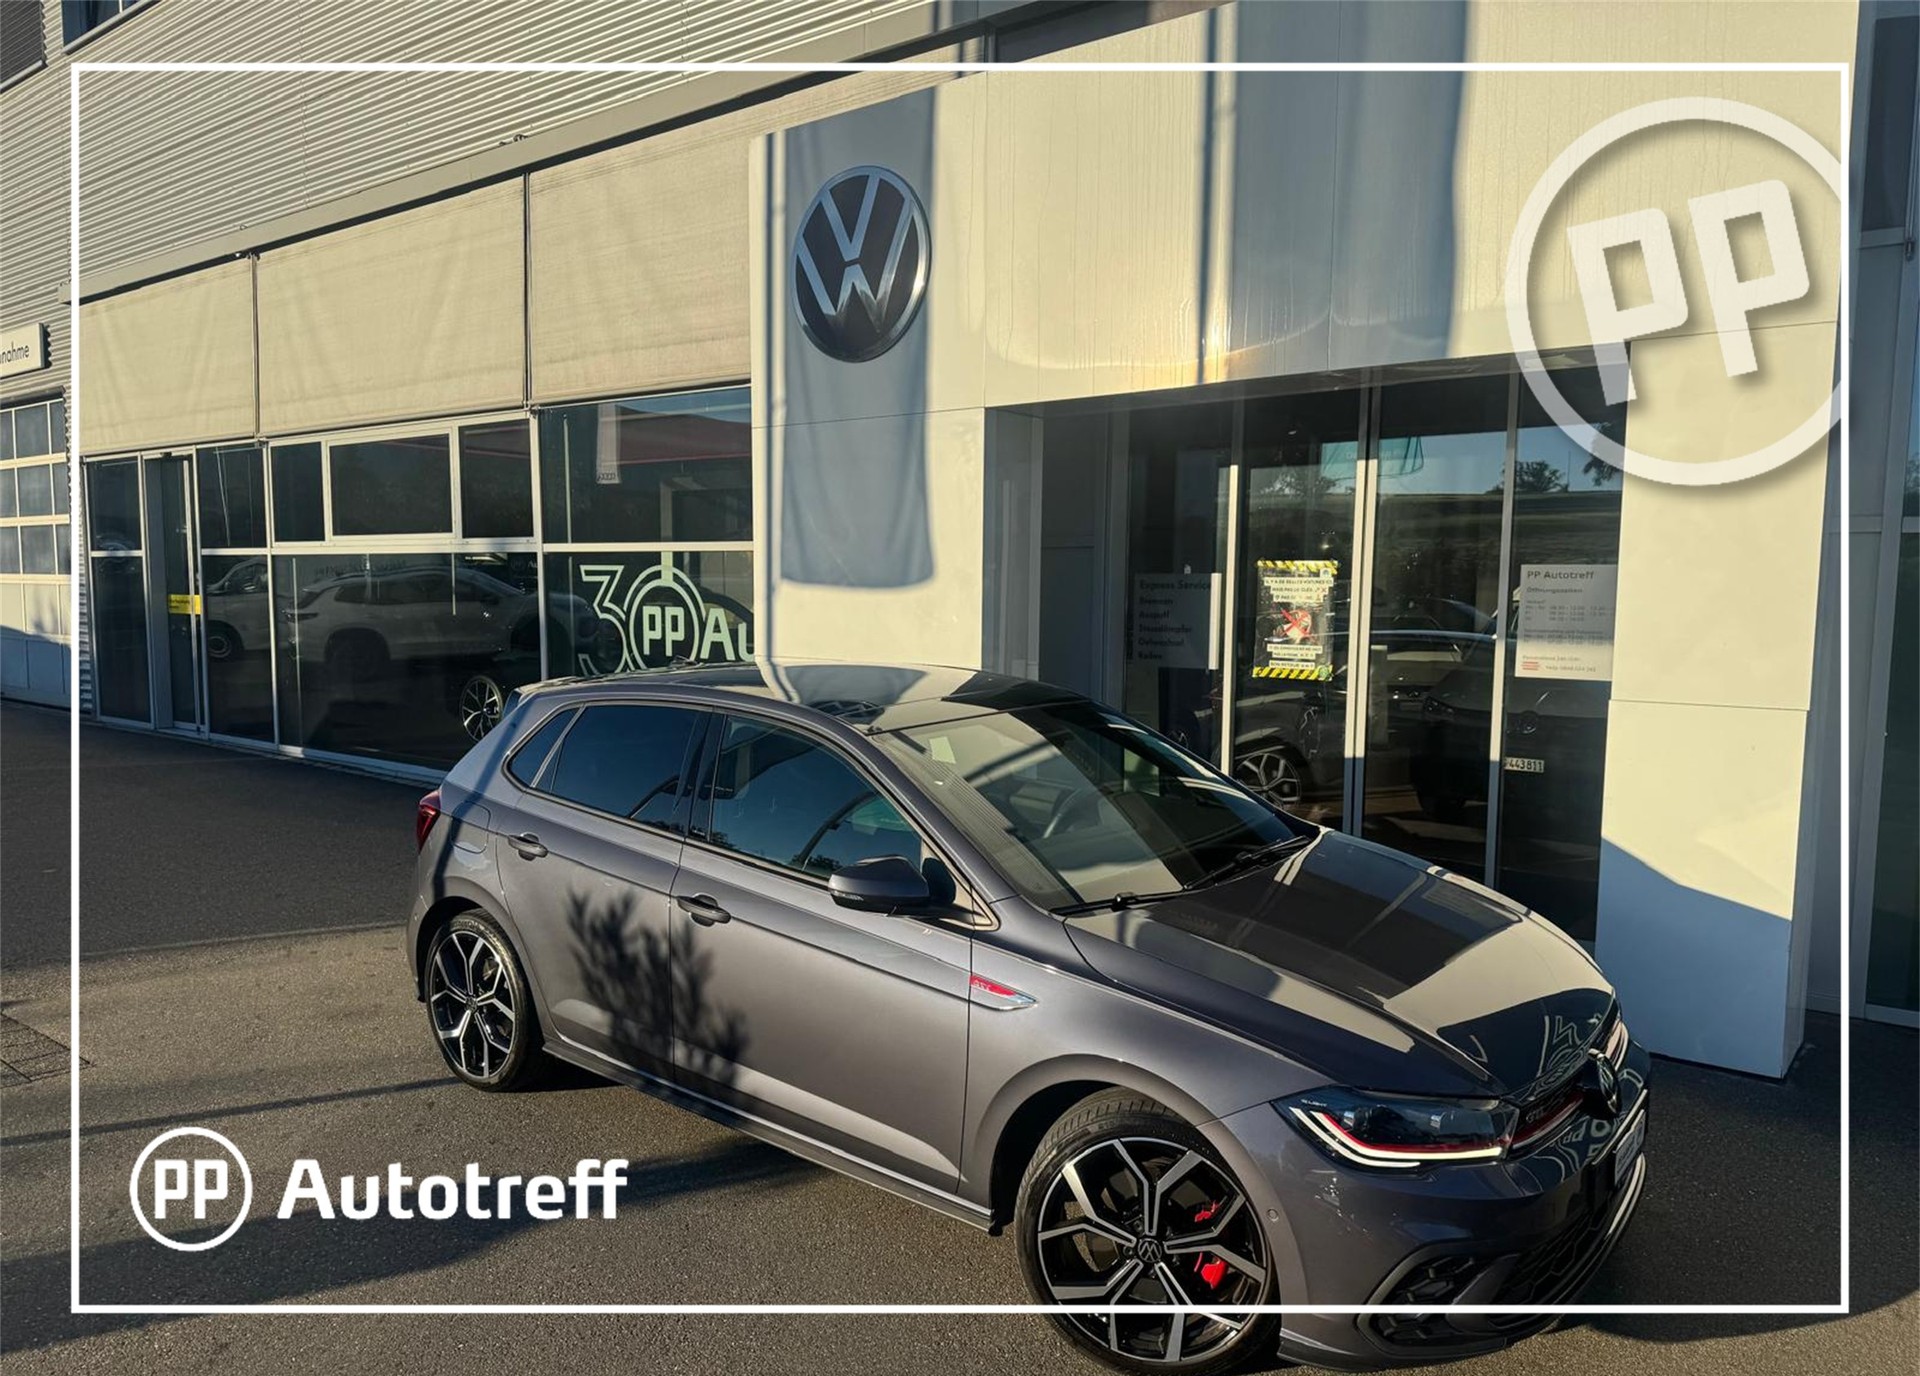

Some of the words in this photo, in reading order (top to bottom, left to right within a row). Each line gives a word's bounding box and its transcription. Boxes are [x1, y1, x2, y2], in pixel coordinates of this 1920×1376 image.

[1527, 570, 1541, 579] PP
[1544, 570, 1594, 579] Autotreff
[642, 605, 685, 657] PP
